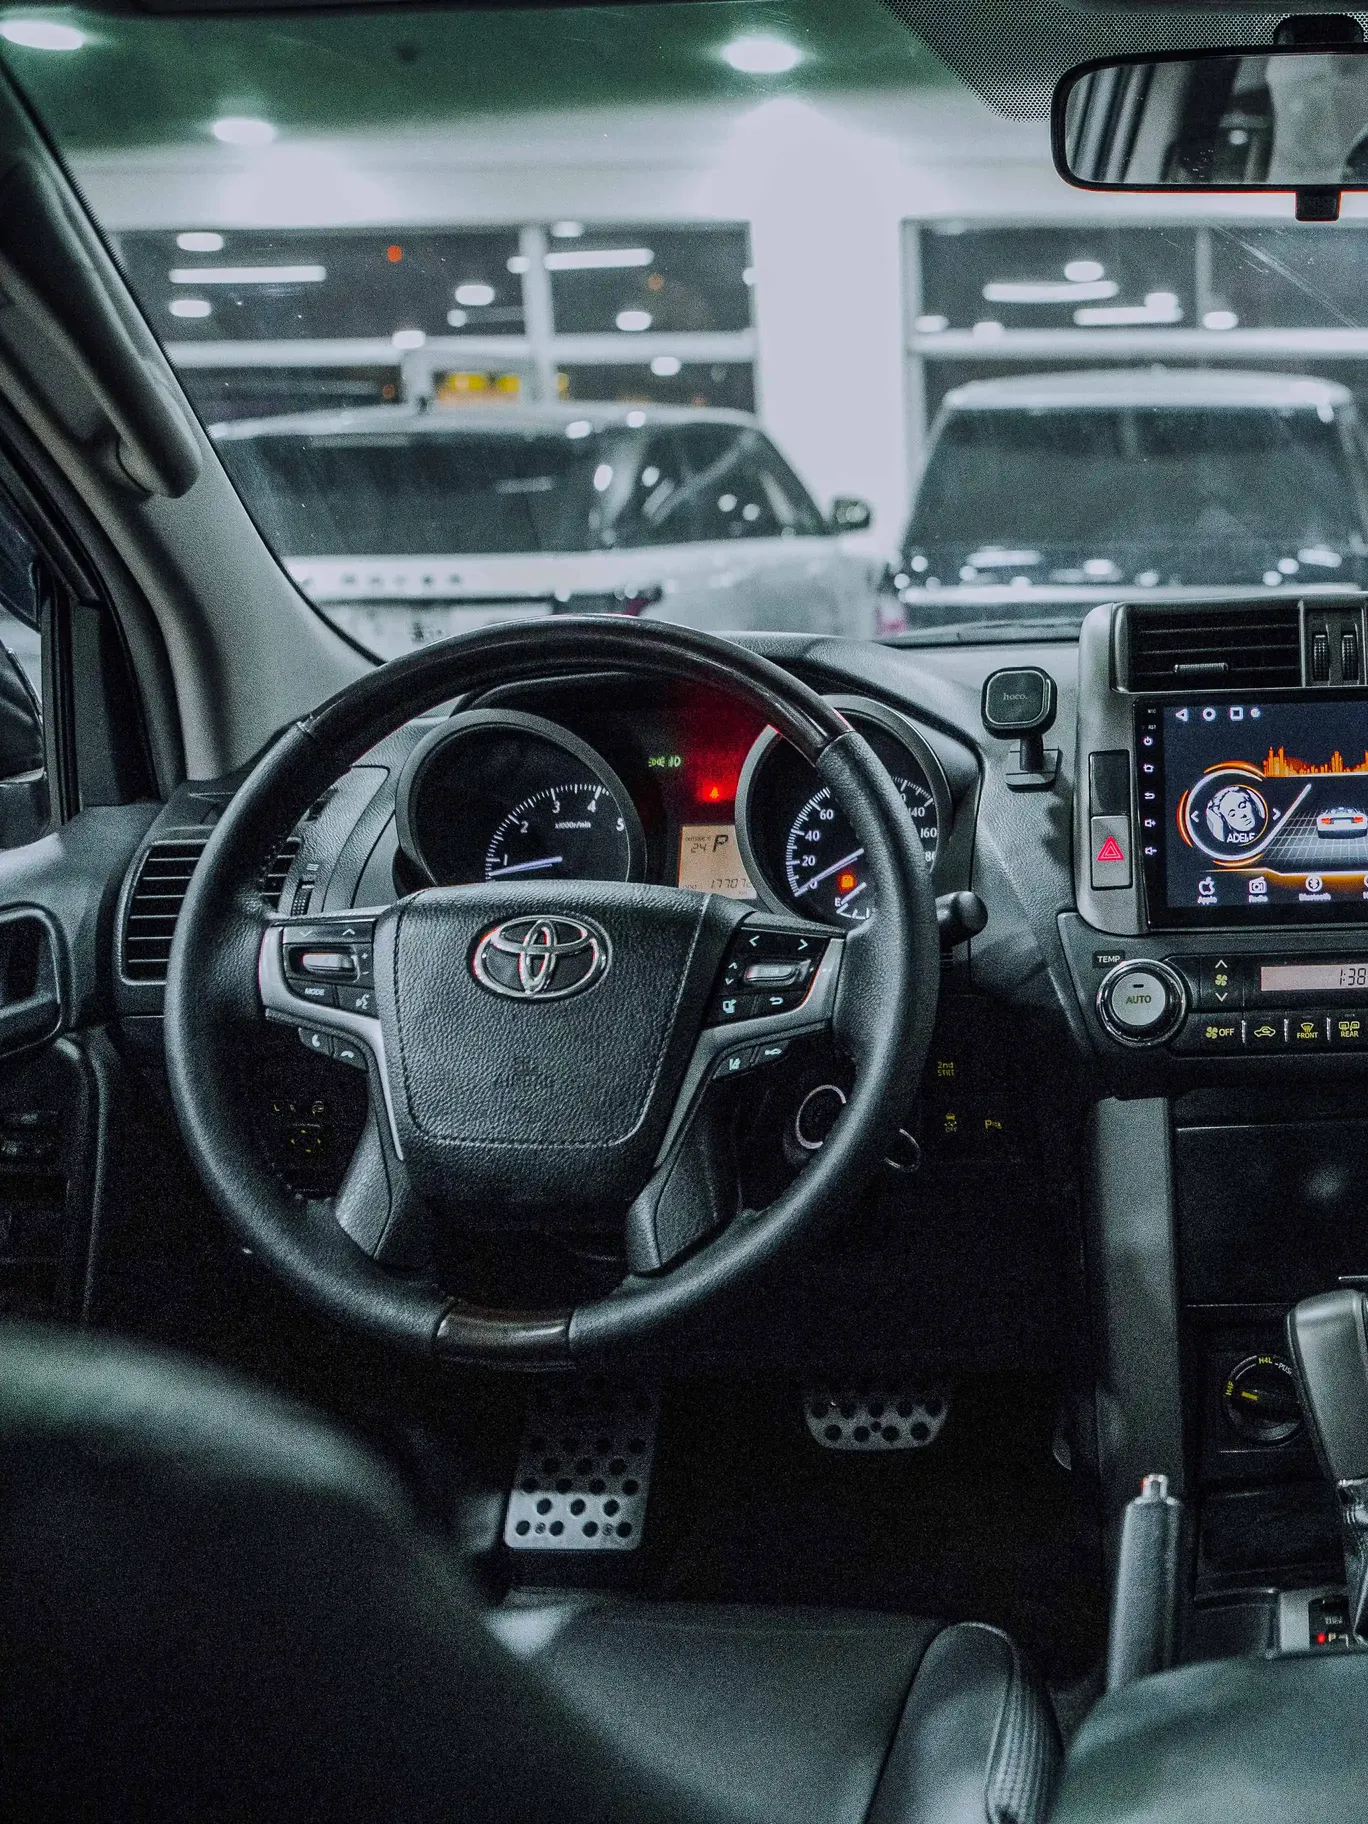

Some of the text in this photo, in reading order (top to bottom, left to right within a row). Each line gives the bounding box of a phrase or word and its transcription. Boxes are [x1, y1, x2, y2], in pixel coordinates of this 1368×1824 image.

[1003, 692, 1028, 701] hoco.
[551, 801, 561, 814] 3
[587, 800, 597, 813] 4
[819, 809, 834, 820] 60
[520, 821, 529, 833] 2
[616, 818, 625, 831] 5
[805, 830, 820, 841] 40
[920, 827, 937, 838] 160
[712, 834, 729, 853] P
[503, 854, 508, 866] 1
[802, 855, 816, 867] 20
[835, 897, 841, 907] E
[1097, 955, 1121, 963] TEMP
[1340, 967, 1367, 986] 1:38
[304, 987, 325, 996] MODE
[1125, 995, 1152, 1004] AUTO
[1218, 1028, 1235, 1037] OFF
[1297, 1031, 1319, 1039] FRONT
[1340, 1030, 1359, 1038] REAR
[937, 1061, 954, 1069] 2nd
